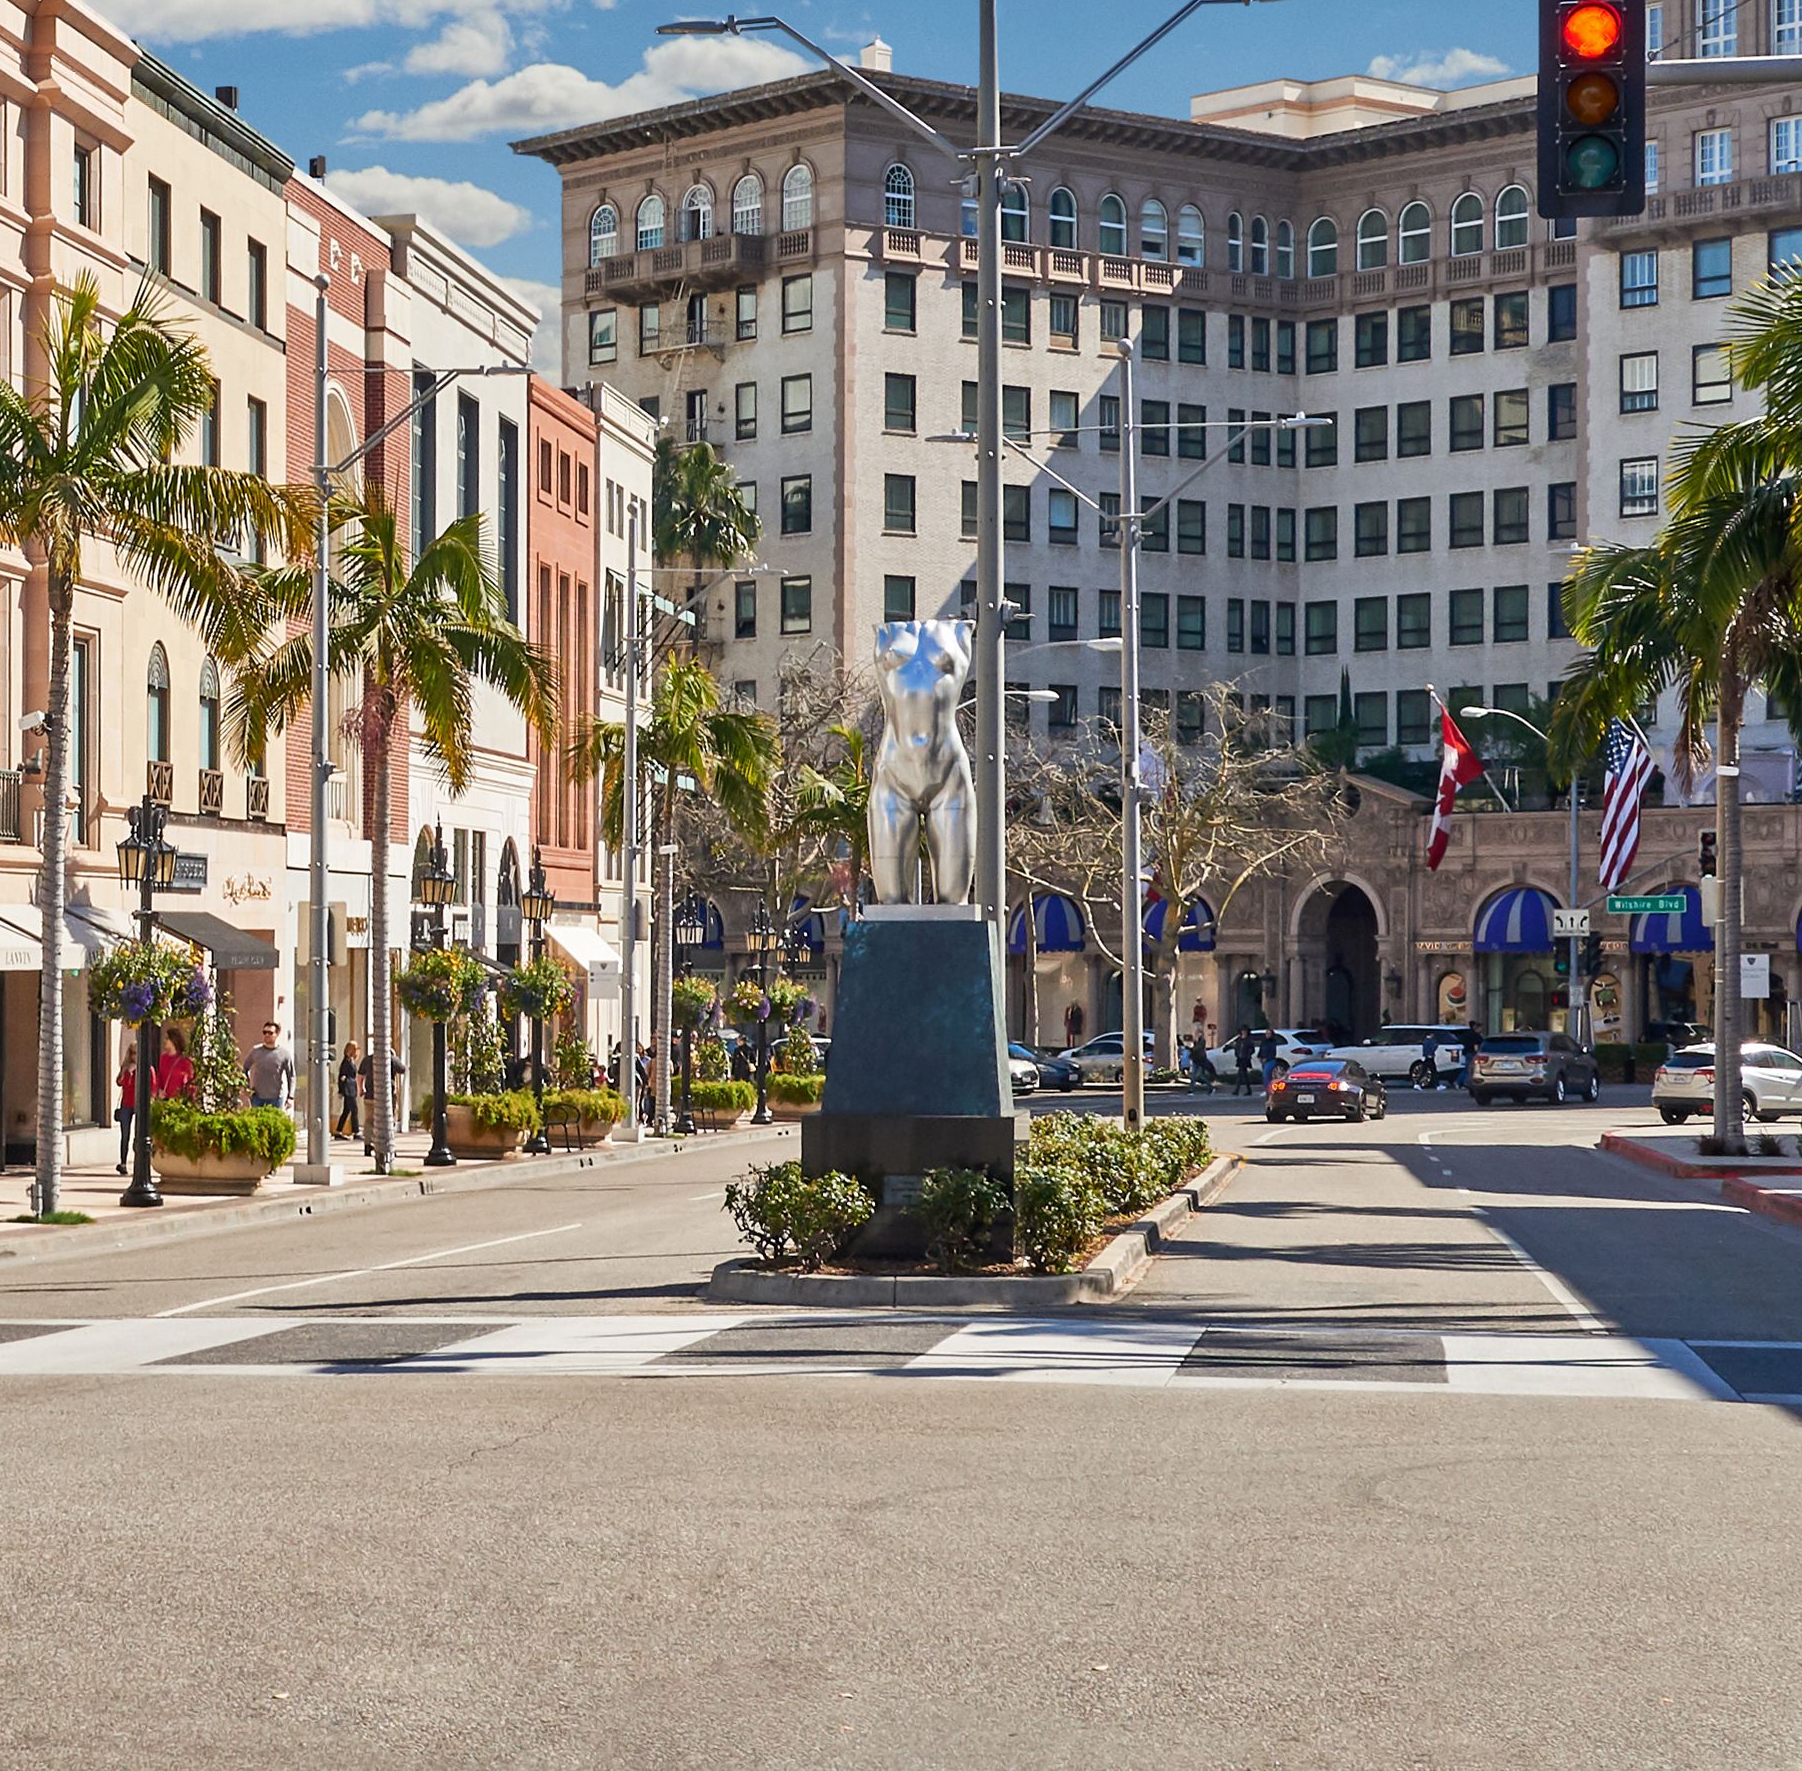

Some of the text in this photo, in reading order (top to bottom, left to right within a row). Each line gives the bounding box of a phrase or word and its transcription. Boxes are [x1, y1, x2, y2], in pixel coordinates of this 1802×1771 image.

[1615, 899, 1679, 909] Wilshire Blvd
[5, 951, 31, 965] LANVIN
